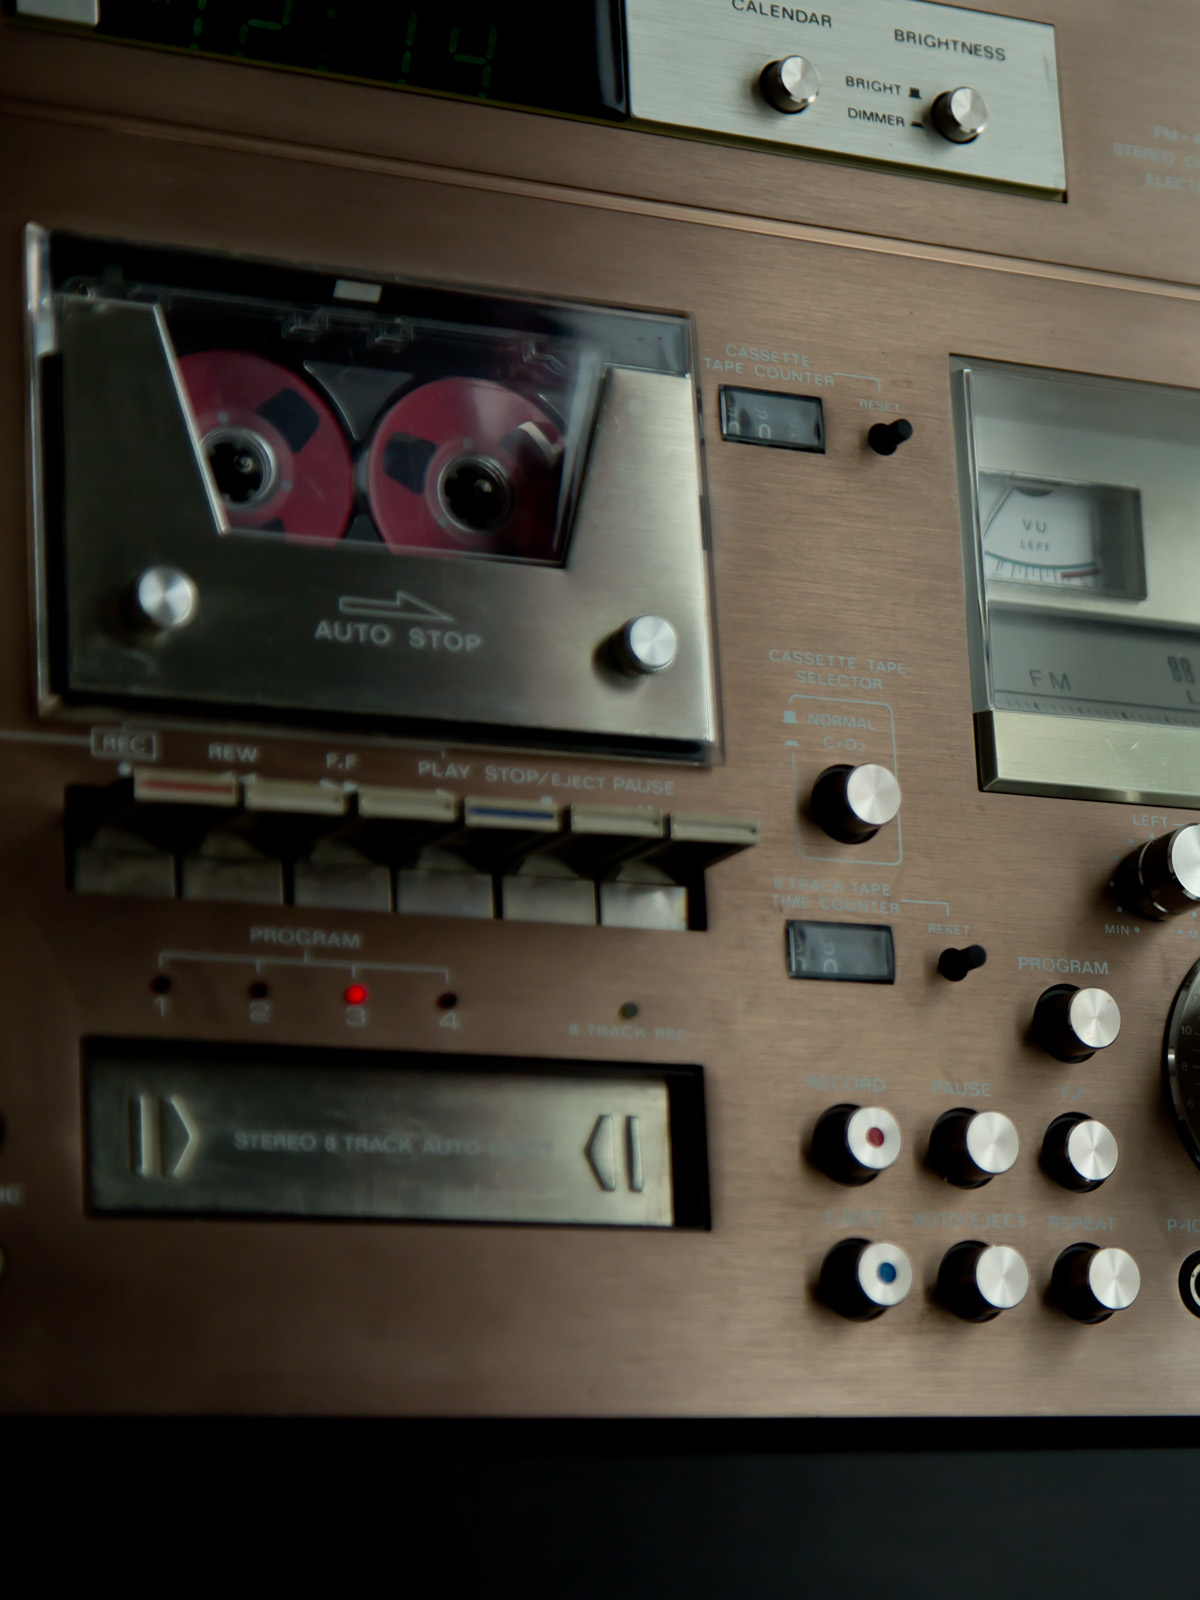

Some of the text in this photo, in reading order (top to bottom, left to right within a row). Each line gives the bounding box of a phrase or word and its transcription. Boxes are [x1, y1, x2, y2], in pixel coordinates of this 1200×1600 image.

[731, 0, 832, 28] CALENDAR
[894, 29, 1006, 61] BRIGHTNESS
[845, 76, 901, 95] BRIGHT
[847, 107, 905, 127] DIMMER
[1112, 142, 1176, 166] STEREO
[726, 344, 811, 368] CASSETTE
[704, 357, 835, 388] TAPE COUNTER
[859, 397, 901, 413] RESET
[1020, 539, 1050, 552] LEFT
[314, 619, 482, 652] AUTO STOP
[768, 648, 906, 675] CASSETTE TAPE
[795, 669, 884, 691] SELECTOR
[1029, 669, 1071, 691] FM
[807, 712, 877, 731] NORMAL
[102, 734, 148, 754] REC
[208, 743, 259, 763] REW
[418, 760, 471, 778] PLAY
[484, 765, 606, 790] STOP/EJECT
[613, 776, 675, 796] PAUSE
[1132, 814, 1169, 829] LEFT
[788, 877, 843, 894] TRACK
[850, 881, 892, 897] TAPE
[771, 893, 901, 916] TIME COUNTER
[250, 926, 363, 948] PROGRAM
[927, 922, 971, 937] RESET
[1105, 924, 1130, 936] MIN
[1018, 956, 1109, 976] PROGRAM
[153, 996, 170, 1018] 1
[249, 1001, 271, 1024] 2
[344, 1006, 367, 1028] 3
[438, 1012, 460, 1031] 4
[1181, 1026, 1192, 1036] 10
[587, 1024, 646, 1040] TRACK
[805, 1074, 886, 1094] RECORD
[931, 1080, 993, 1098] PAUSE
[233, 1131, 318, 1152] STEREO
[341, 1134, 413, 1155] TRACK
[969, 1213, 1027, 1230] EJECT
[1047, 1215, 1116, 1232] REPEAT
